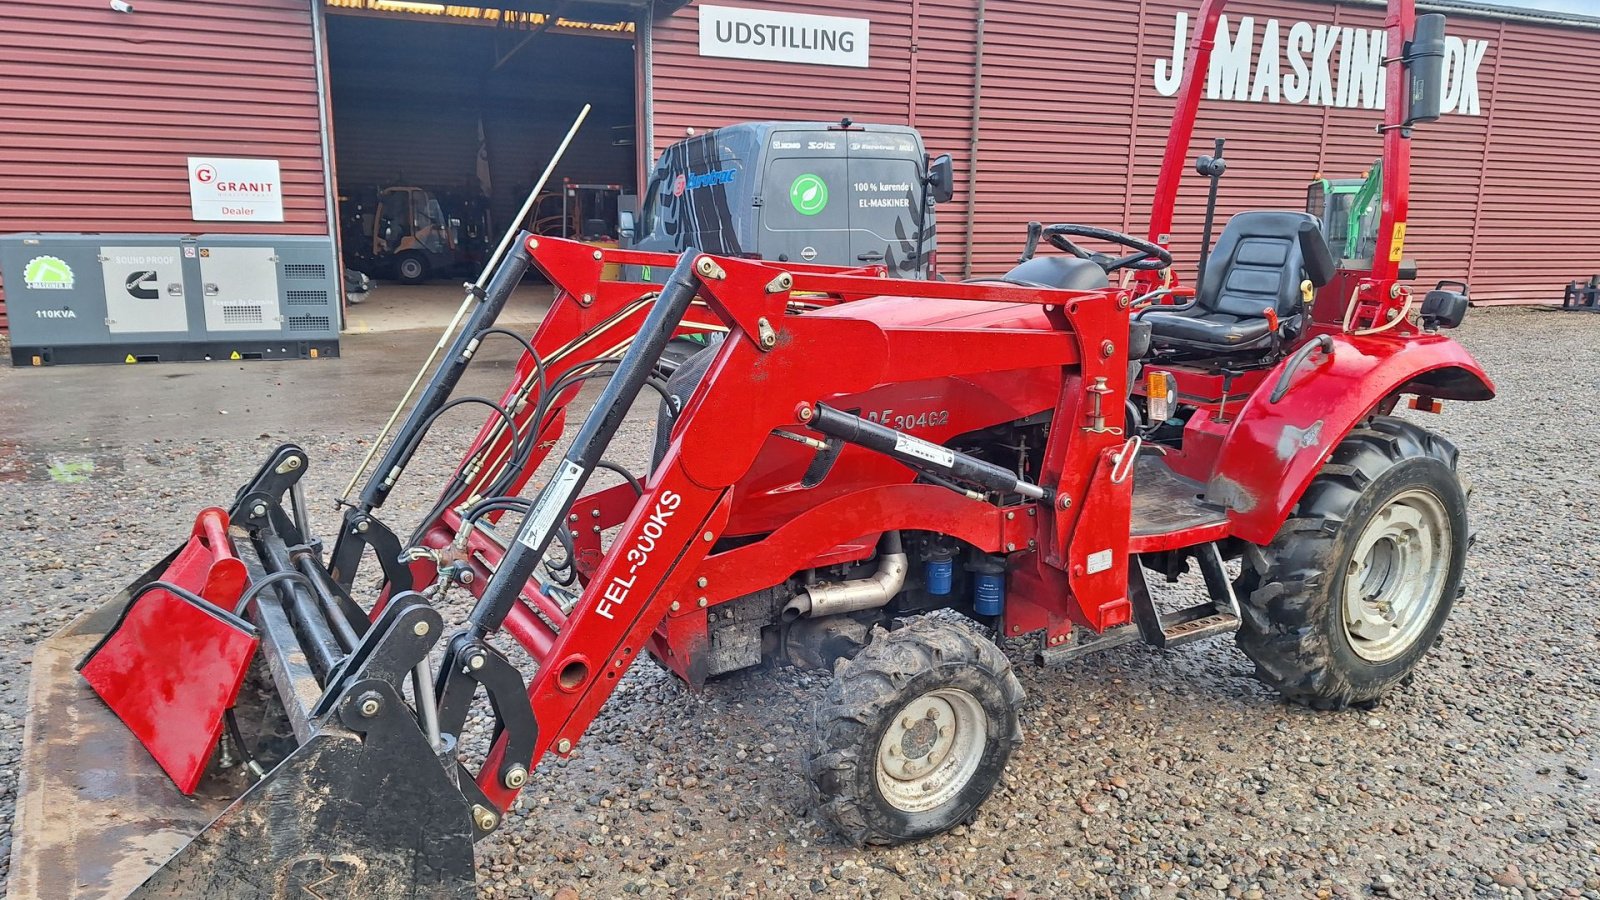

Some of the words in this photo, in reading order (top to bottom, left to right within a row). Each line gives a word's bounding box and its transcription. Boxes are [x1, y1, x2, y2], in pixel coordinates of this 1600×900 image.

[715, 20, 854, 53] UDSTILLING
[217, 182, 273, 192] GRANIT
[853, 182, 869, 191] 100
[870, 183, 878, 192] %
[879, 182, 909, 191] kørende
[859, 198, 910, 208] EL-MASKINER
[222, 207, 254, 216] Dealer
[115, 256, 145, 264] SOUND
[146, 255, 174, 264] PROOF
[36, 310, 76, 318] 110KVA
[595, 490, 681, 620] FEL-300KS
